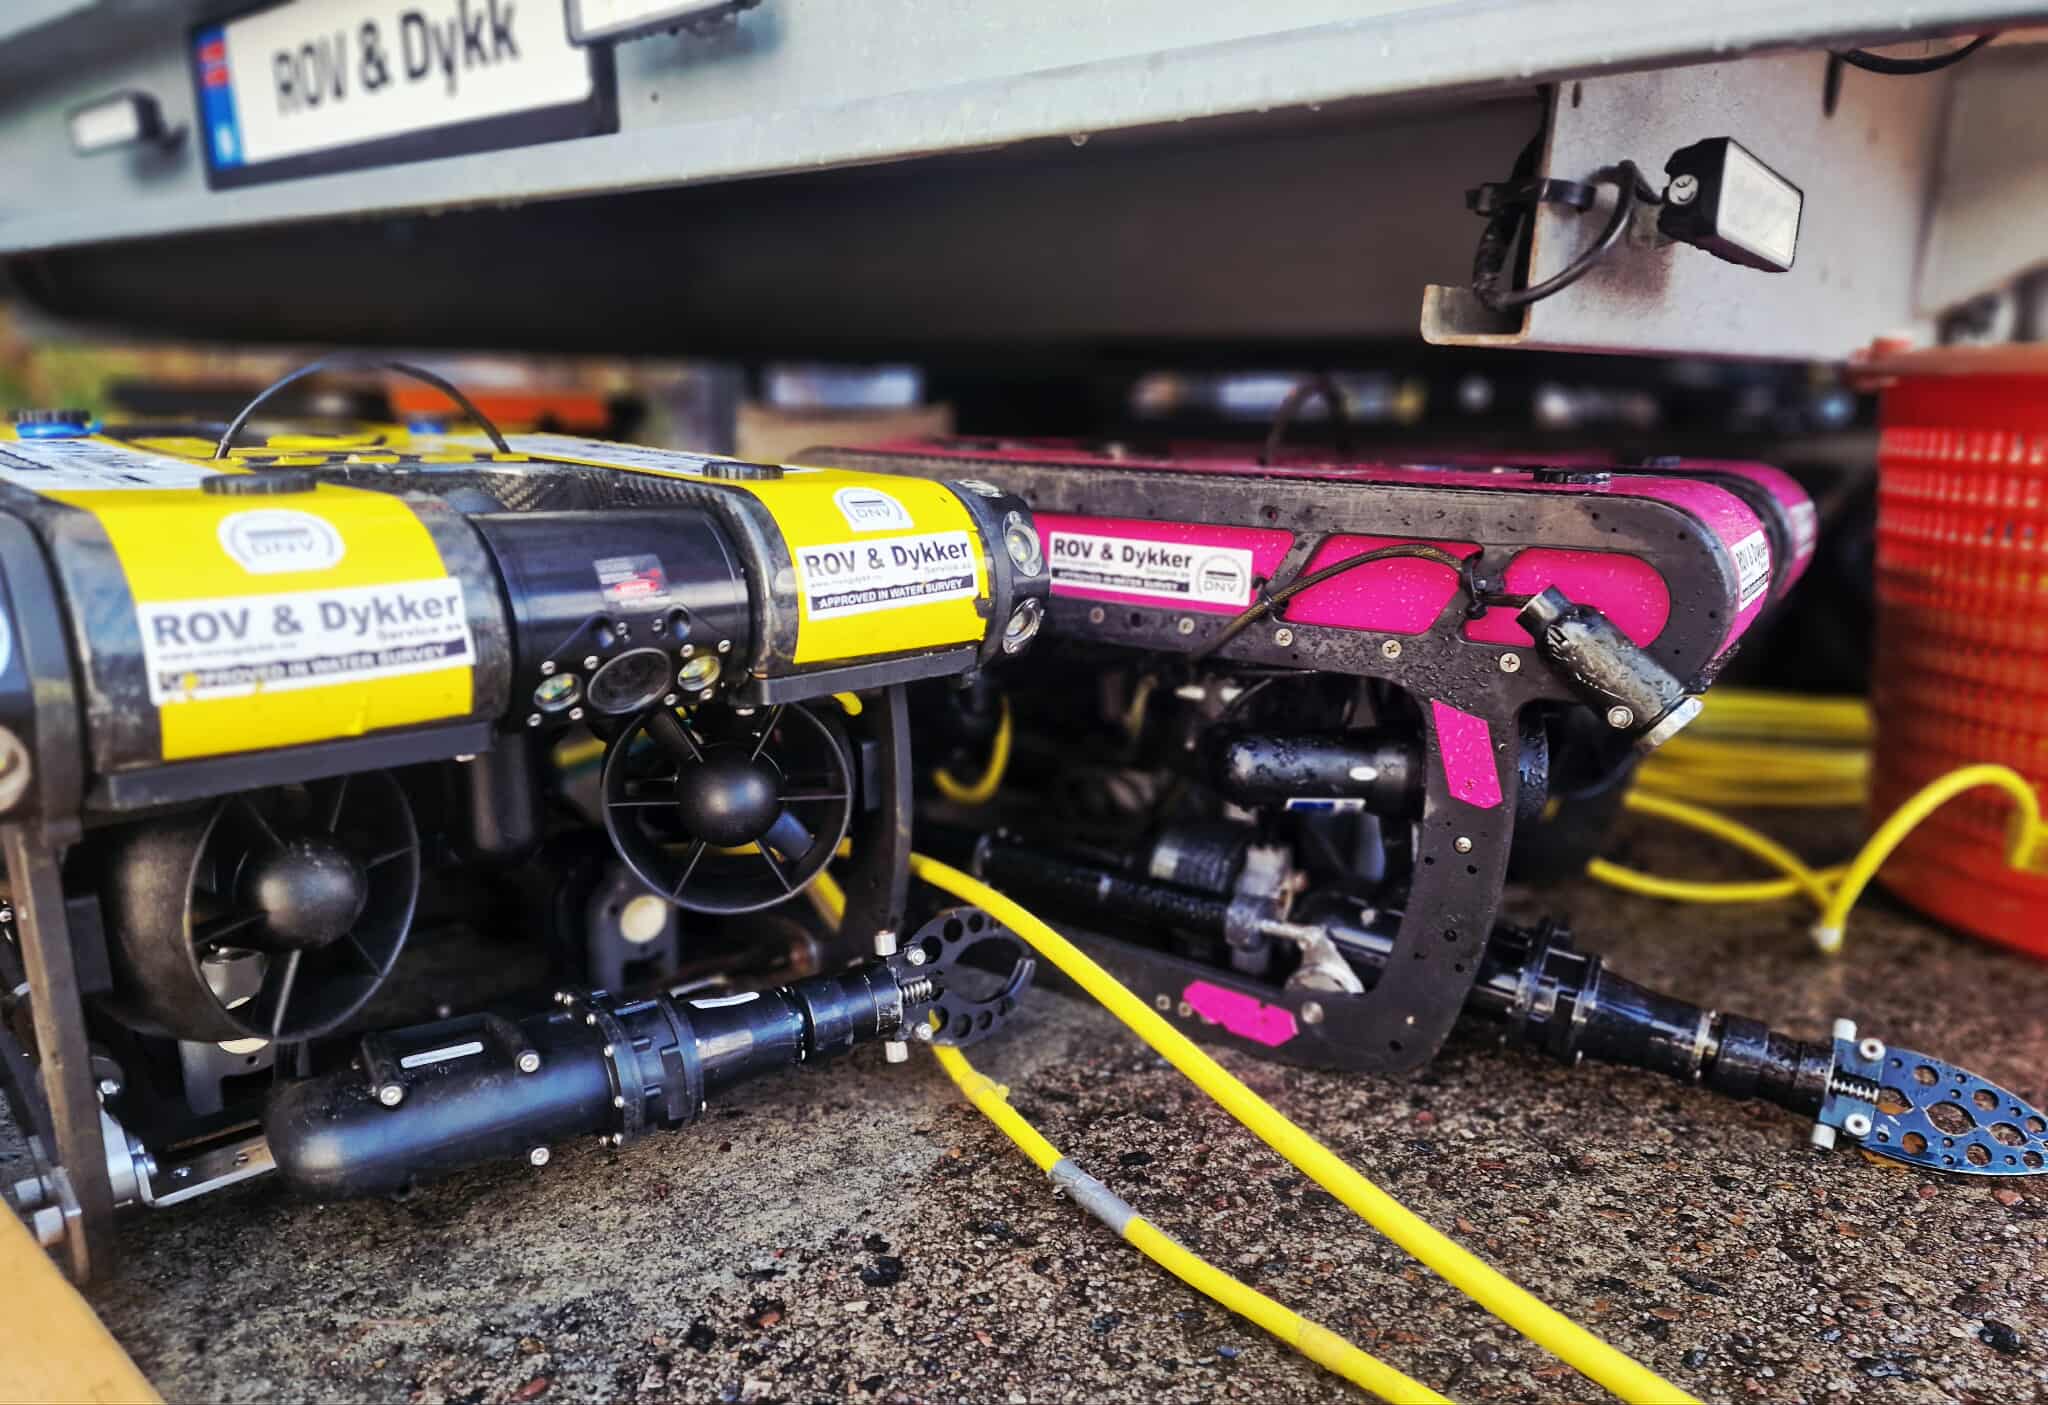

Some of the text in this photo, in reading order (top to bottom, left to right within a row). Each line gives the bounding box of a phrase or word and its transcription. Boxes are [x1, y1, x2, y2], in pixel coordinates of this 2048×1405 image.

[273, 0, 519, 114] ROV & Dykk
[855, 506, 890, 519] DNV
[805, 540, 968, 578] ROV & Dykker
[1053, 538, 1093, 558] ROV
[1101, 542, 1113, 561] &
[1122, 545, 1193, 569] Dykker
[818, 578, 963, 609] APPROVED IN WATER SURVEY
[1203, 580, 1237, 593] DNV
[152, 594, 459, 647] ROV & Dykker
